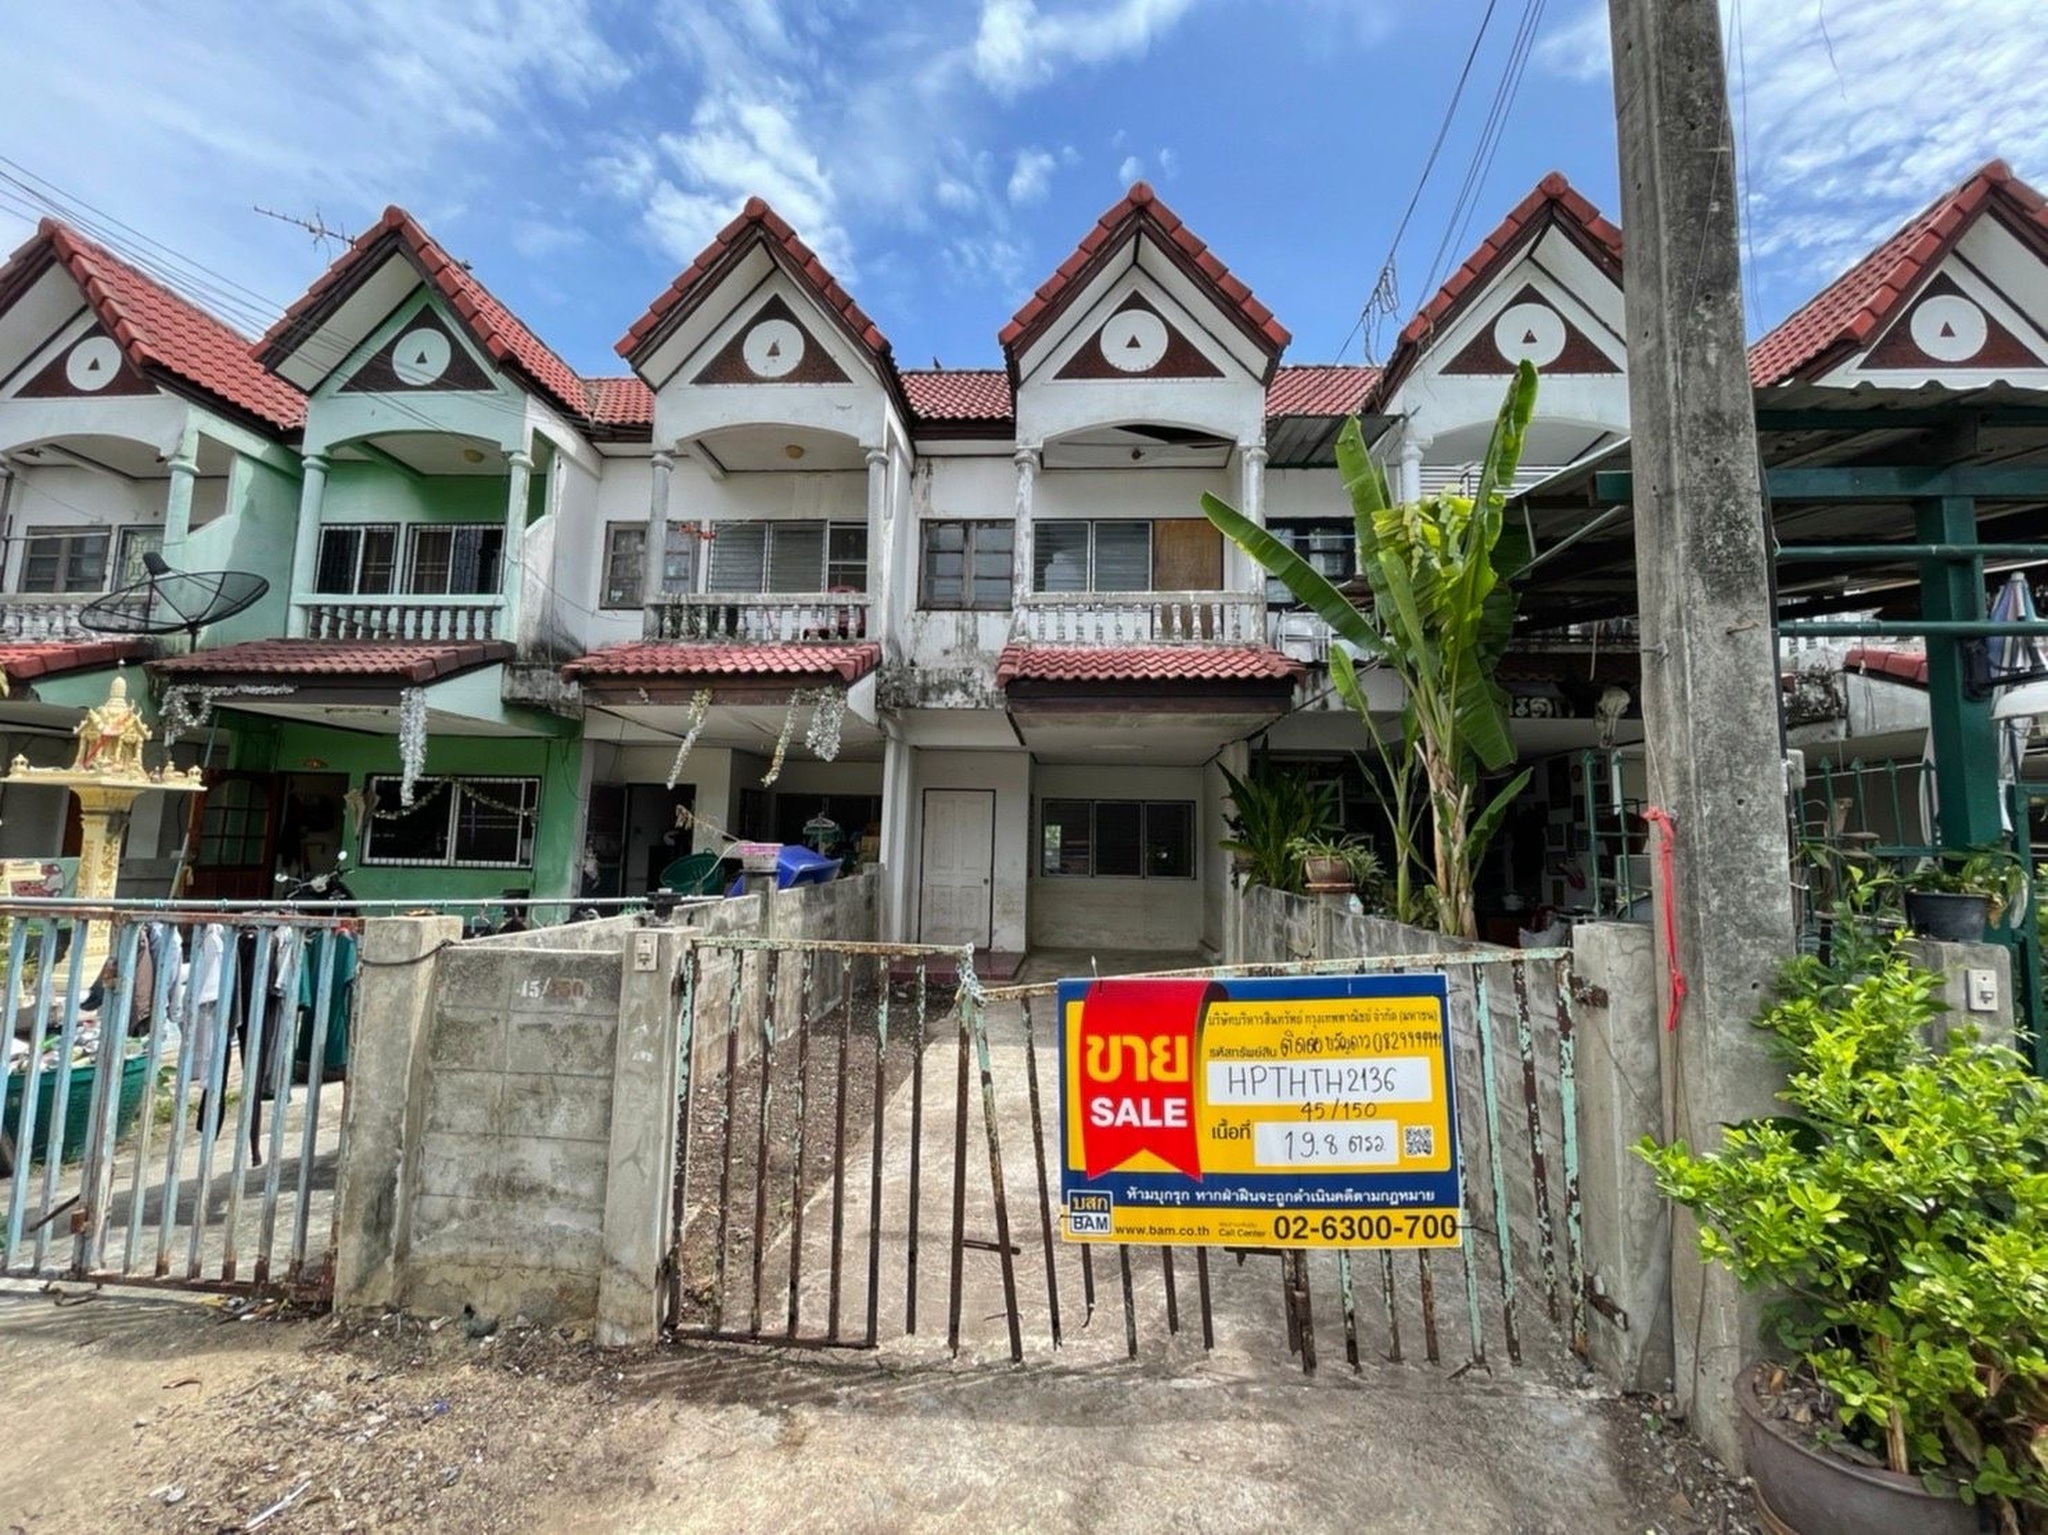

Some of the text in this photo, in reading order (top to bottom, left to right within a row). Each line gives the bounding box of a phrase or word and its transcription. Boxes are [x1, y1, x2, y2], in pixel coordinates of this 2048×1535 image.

[1086, 1035, 1189, 1082] ขาย
[1228, 1065, 1397, 1098] HPTHTH2136
[1090, 1096, 1188, 1128] SALE
[1300, 1098, 1377, 1122] 45/150
[1211, 1119, 1251, 1140] เนื้อที่
[1126, 1186, 1190, 1205] ห้ามบุกรุก
[1072, 1215, 1109, 1231] BAM
[1115, 1225, 1210, 1237] www.bam.co.th
[1219, 1228, 1266, 1238] Call Center
[1273, 1214, 1458, 1240] 02-6300-700
